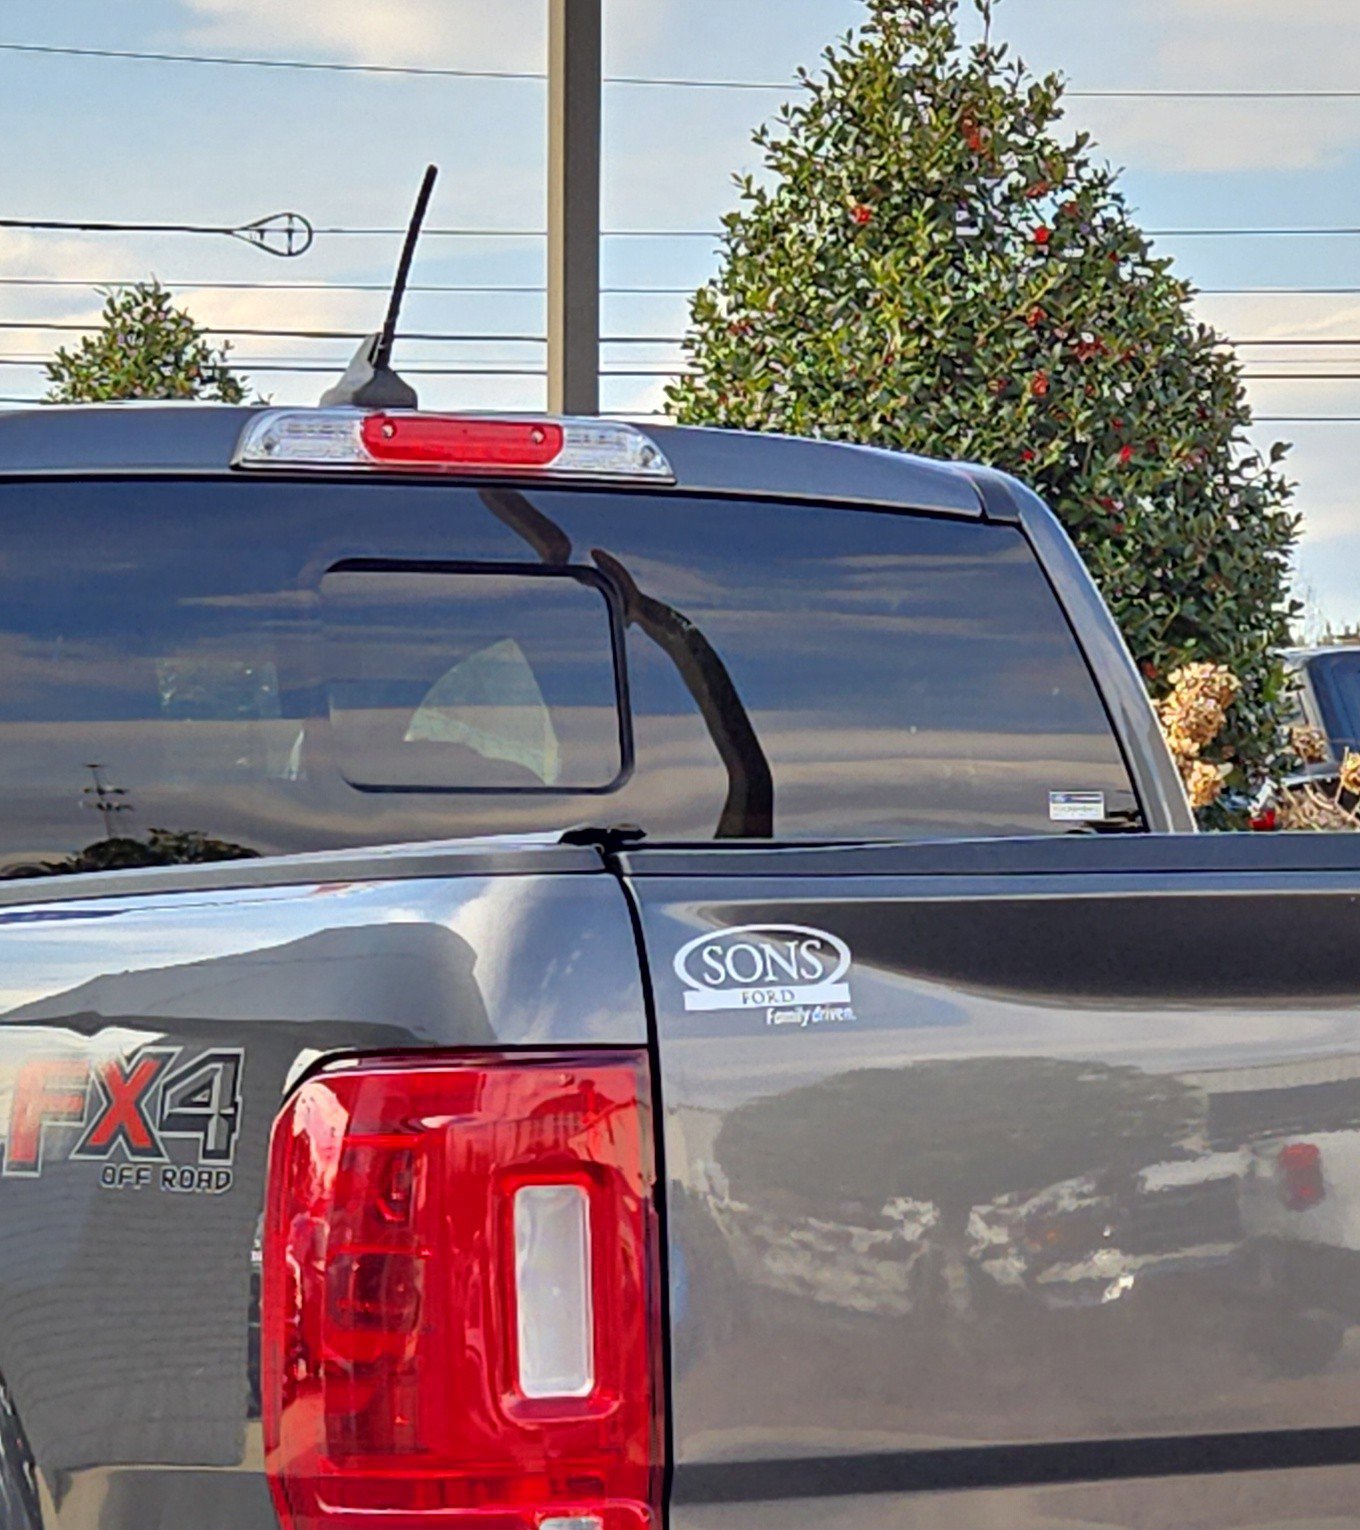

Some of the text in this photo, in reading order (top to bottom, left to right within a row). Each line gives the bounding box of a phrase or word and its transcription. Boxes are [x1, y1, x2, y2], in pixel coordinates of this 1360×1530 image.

[702, 939, 824, 985] SONS
[742, 989, 795, 1005] FORD
[2, 1046, 245, 1178] FX4
[100, 1163, 234, 1195] OFF ROAD
